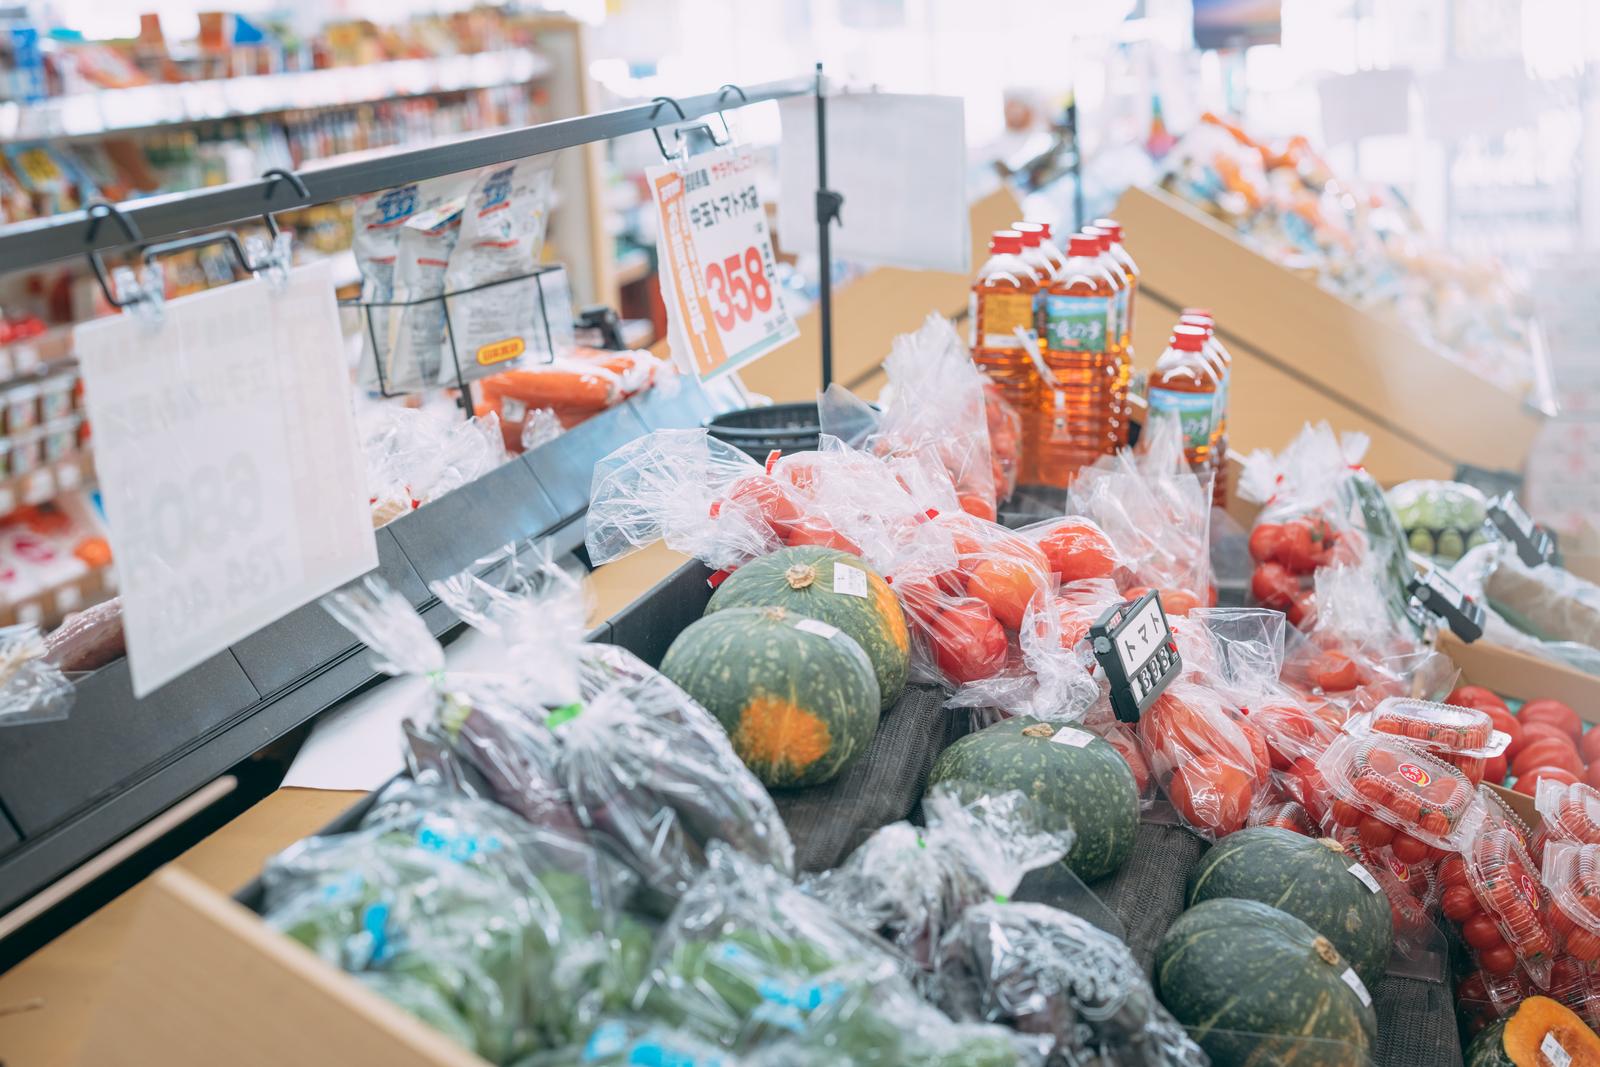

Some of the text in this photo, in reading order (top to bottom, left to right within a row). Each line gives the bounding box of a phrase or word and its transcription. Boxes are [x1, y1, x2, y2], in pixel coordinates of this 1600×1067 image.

[706, 246, 772, 332] 358
[1124, 612, 1160, 662] トマト
[1141, 648, 1169, 691] 398
